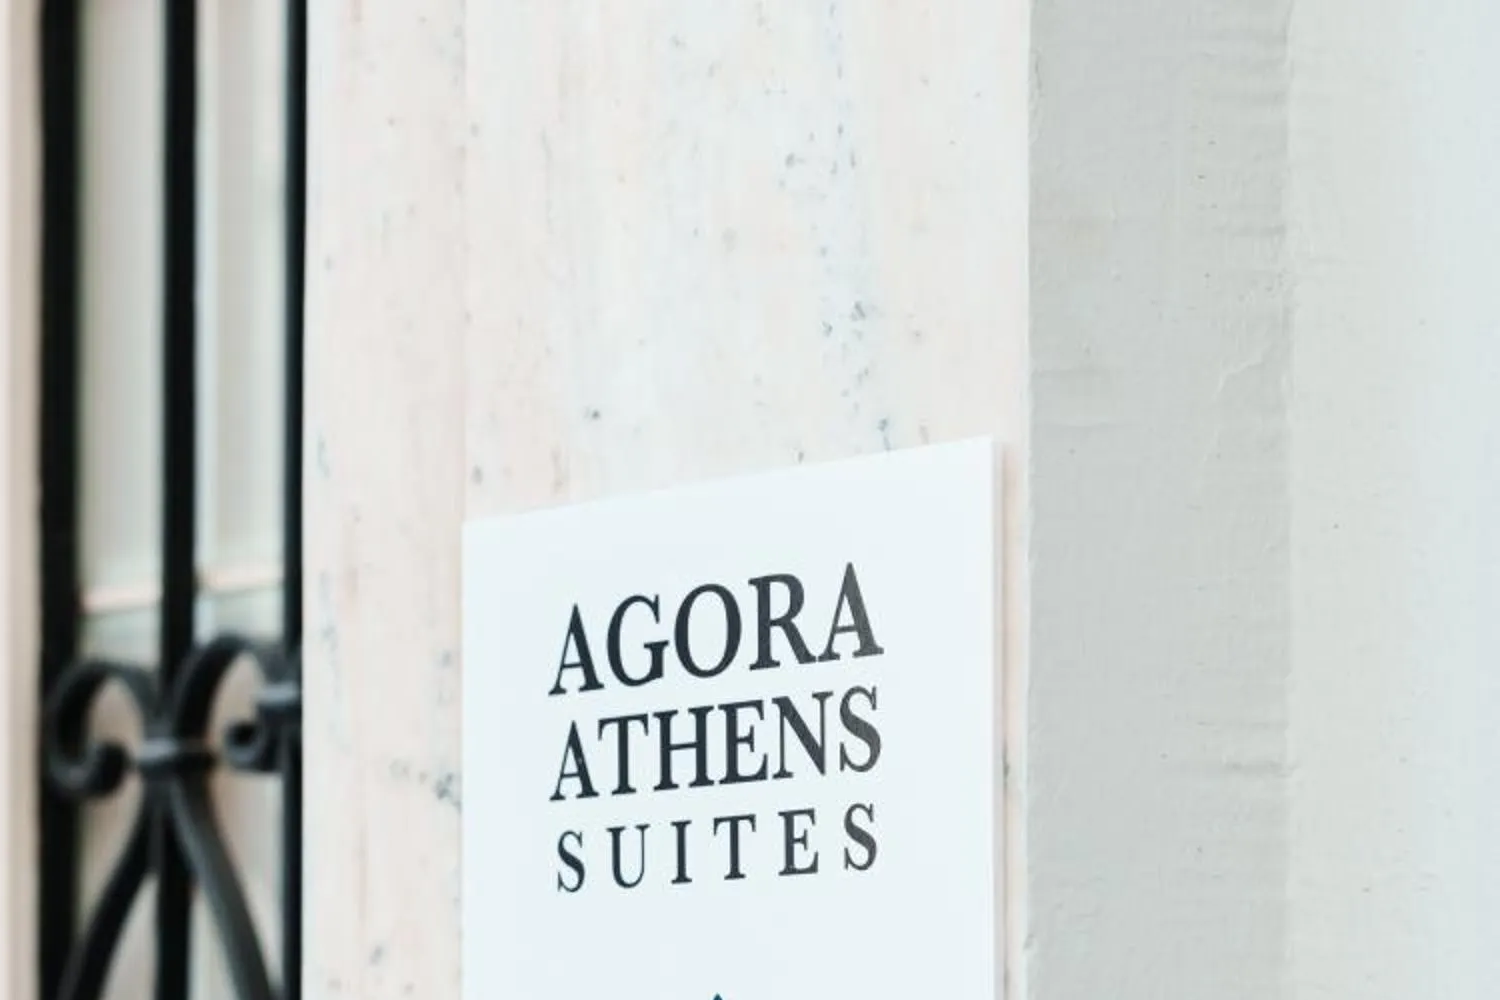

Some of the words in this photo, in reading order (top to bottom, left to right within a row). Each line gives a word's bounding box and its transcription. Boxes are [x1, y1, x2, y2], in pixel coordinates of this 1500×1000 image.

[548, 562, 885, 697] AGORA
[549, 684, 883, 802] ATHENS
[556, 802, 878, 893] SUITES
